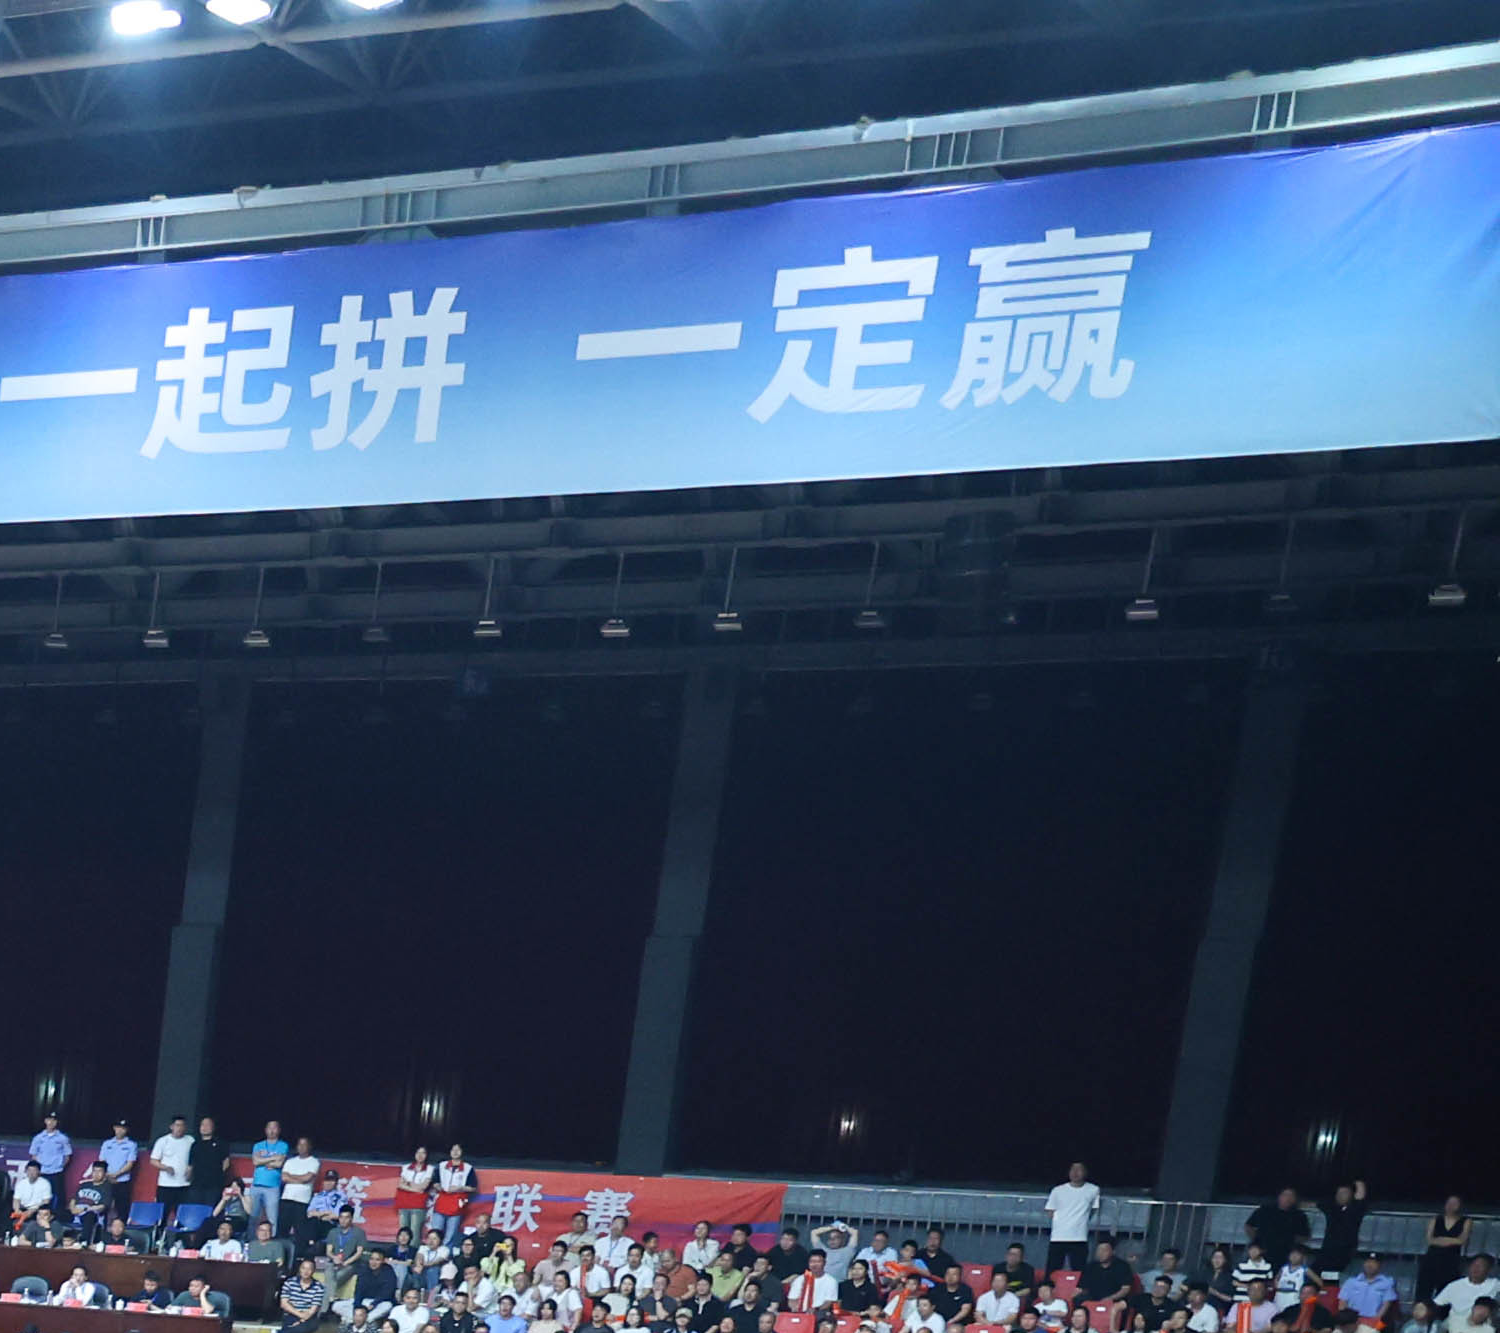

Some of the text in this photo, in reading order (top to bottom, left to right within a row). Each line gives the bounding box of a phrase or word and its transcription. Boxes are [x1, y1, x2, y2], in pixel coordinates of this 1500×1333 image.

[0, 287, 469, 459] 一起拼
[575, 227, 1153, 423] 一定赢
